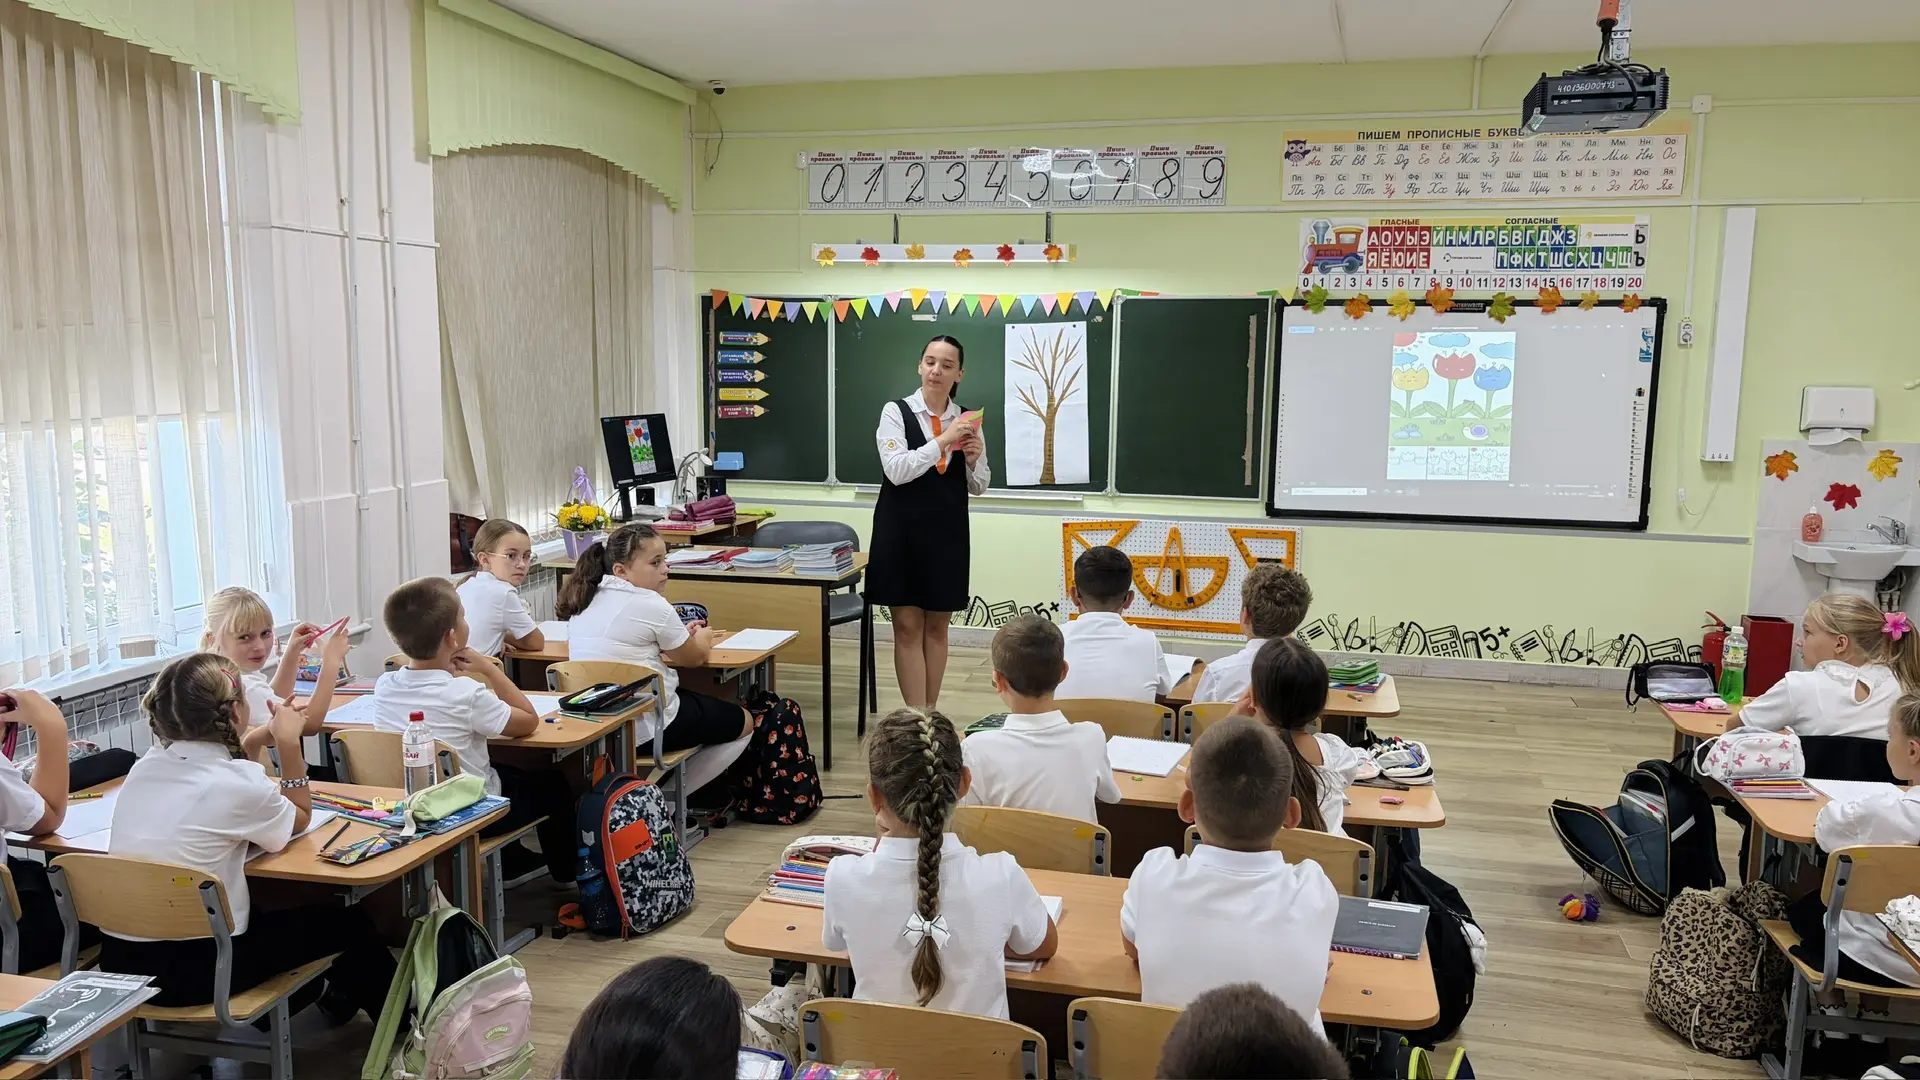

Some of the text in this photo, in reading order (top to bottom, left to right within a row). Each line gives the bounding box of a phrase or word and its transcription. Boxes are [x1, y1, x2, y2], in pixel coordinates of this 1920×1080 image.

[1358, 131, 1401, 140] ПИШЕМ
[1407, 129, 1481, 139] ПРОПИСНЫЕ
[821, 163, 845, 203] 0
[864, 163, 884, 203] 1
[905, 162, 925, 202] 2
[942, 162, 967, 202] 3
[984, 161, 1007, 202] 4
[1153, 158, 1180, 199] 8
[1199, 157, 1225, 199] 9
[1302, 278, 1642, 288] 0 1 2 3 4 5 6 7 8 9 10 11 12 13 14 15 16 17 18 19 20
[1478, 626, 1510, 652] 5+
